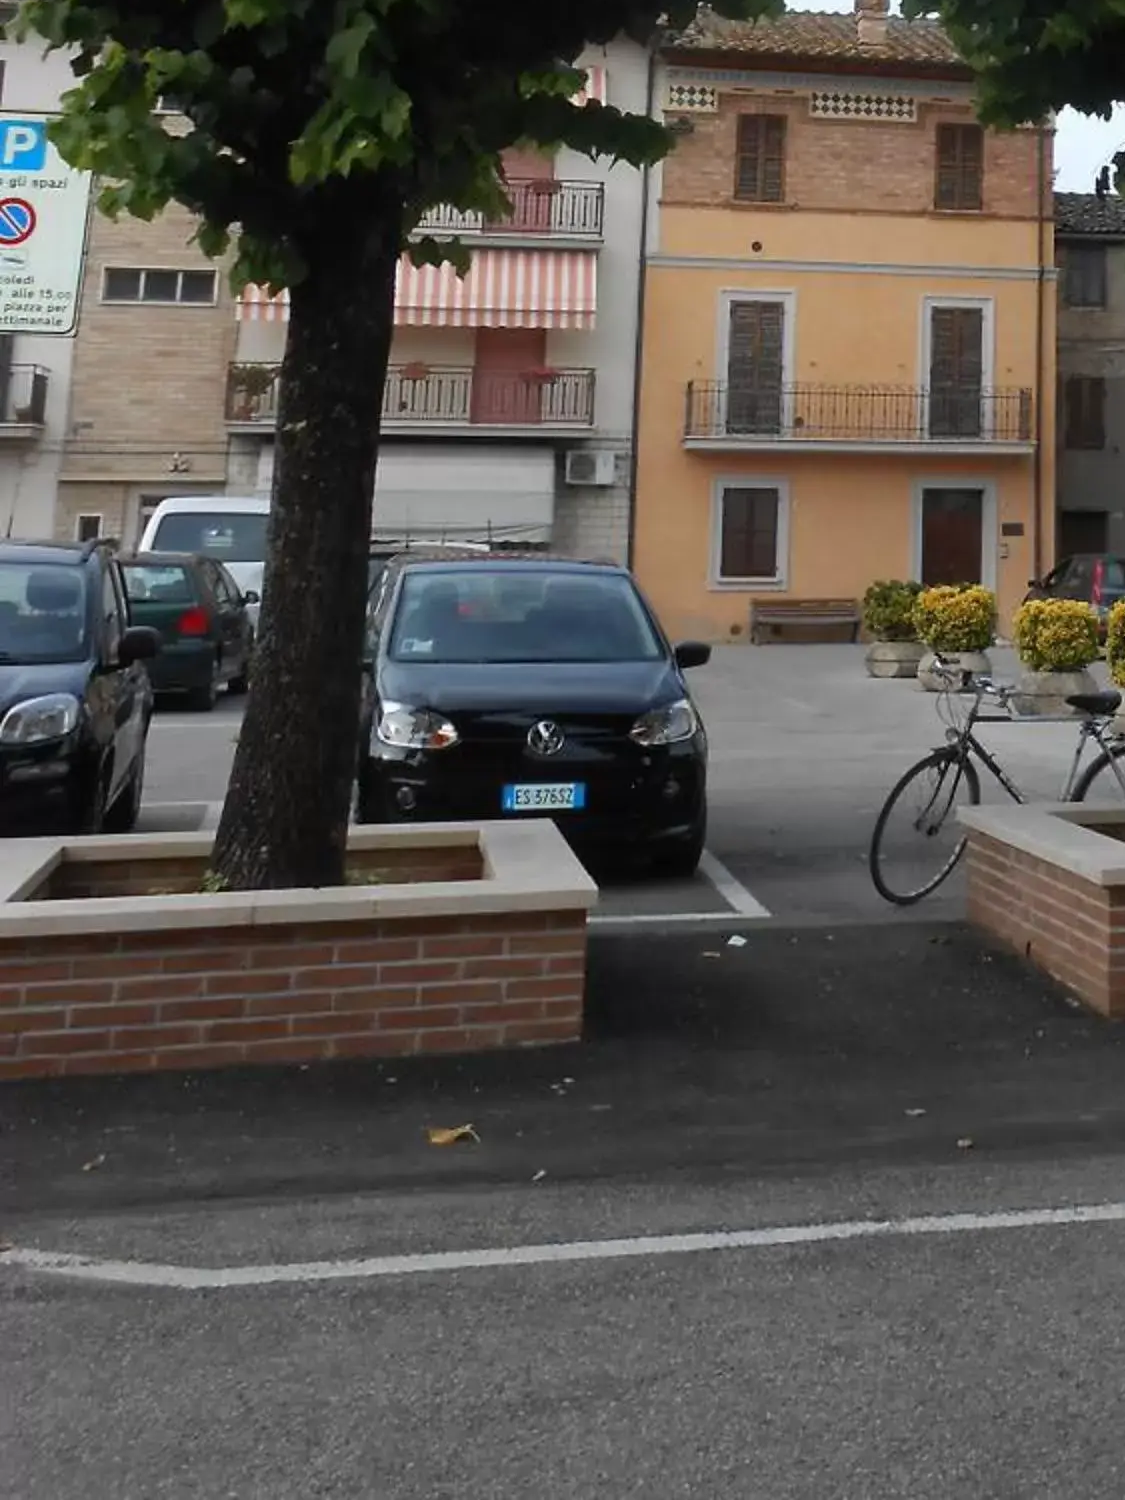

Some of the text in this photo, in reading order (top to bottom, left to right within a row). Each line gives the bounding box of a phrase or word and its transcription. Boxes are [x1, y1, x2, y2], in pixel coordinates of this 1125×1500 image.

[4, 125, 37, 165] P
[32, 177, 68, 189] spazi
[11, 287, 34, 299] alle
[47, 304, 67, 314] per
